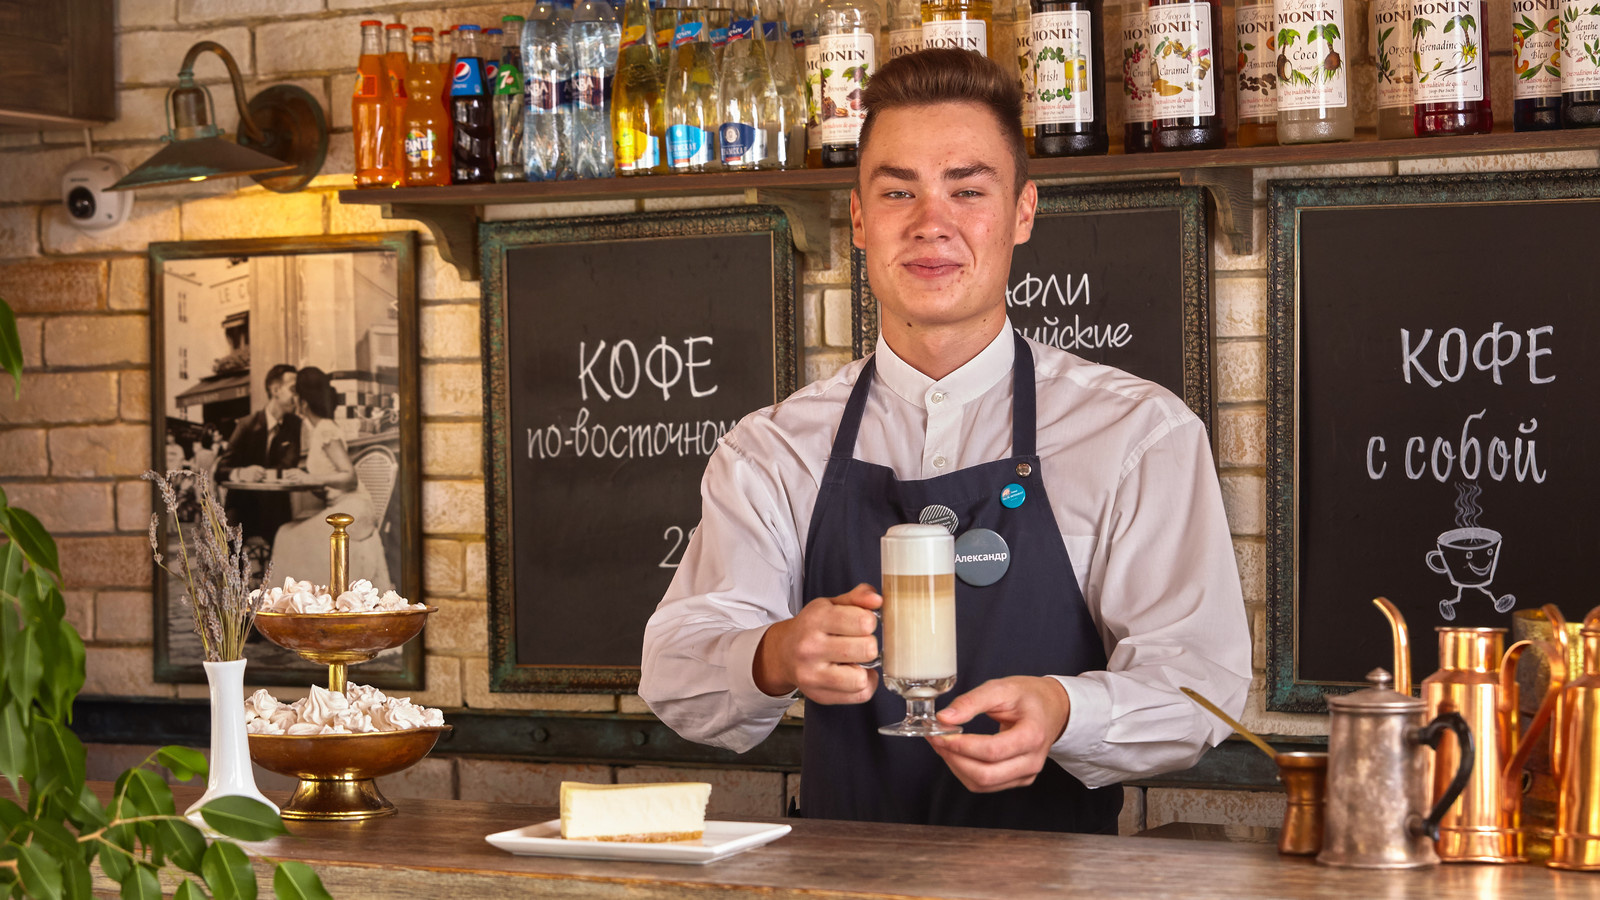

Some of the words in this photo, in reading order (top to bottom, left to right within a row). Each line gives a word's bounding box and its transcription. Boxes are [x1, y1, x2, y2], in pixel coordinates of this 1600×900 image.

[1414, 1, 1470, 16] MONIN
[1278, 10, 1334, 24] MONIN
[1150, 20, 1199, 35] MONIN
[1033, 28, 1080, 42] MONIN
[820, 50, 866, 63] MONIN
[1293, 47, 1318, 60] Coco
[1040, 69, 1059, 82] Irish
[1160, 64, 1189, 76] Caramel
[1014, 314, 1132, 349] ийские
[1400, 322, 1556, 388] КОФЕ
[578, 336, 718, 402] КОФЕ
[1366, 436, 1387, 480] с
[1405, 408, 1547, 484] собой
[658, 526, 703, 568] 2
[954, 552, 1008, 563] Александр
